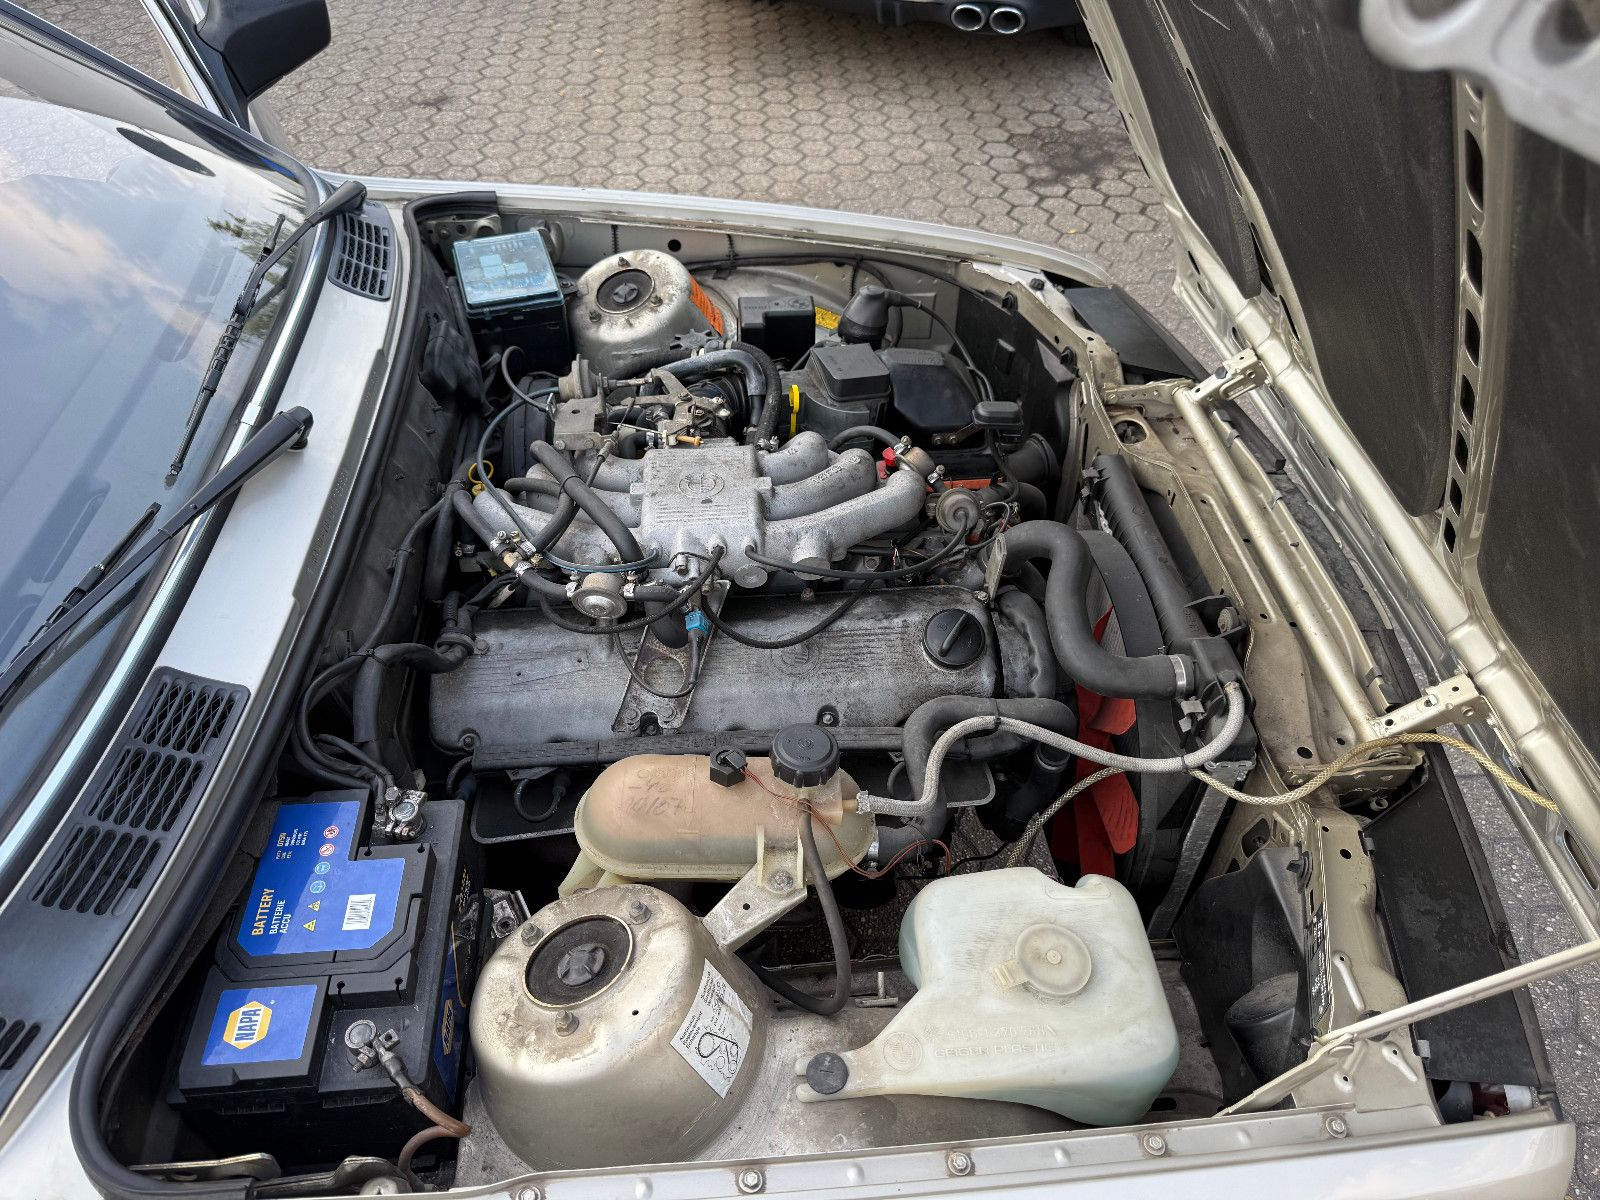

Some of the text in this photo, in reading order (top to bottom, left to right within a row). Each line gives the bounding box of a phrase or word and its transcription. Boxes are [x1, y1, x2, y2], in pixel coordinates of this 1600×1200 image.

[251, 888, 275, 937] BATTERY
[268, 899, 286, 935] BATTERIE
[279, 913, 292, 934] ACCU
[234, 1007, 263, 1043] NAPA
